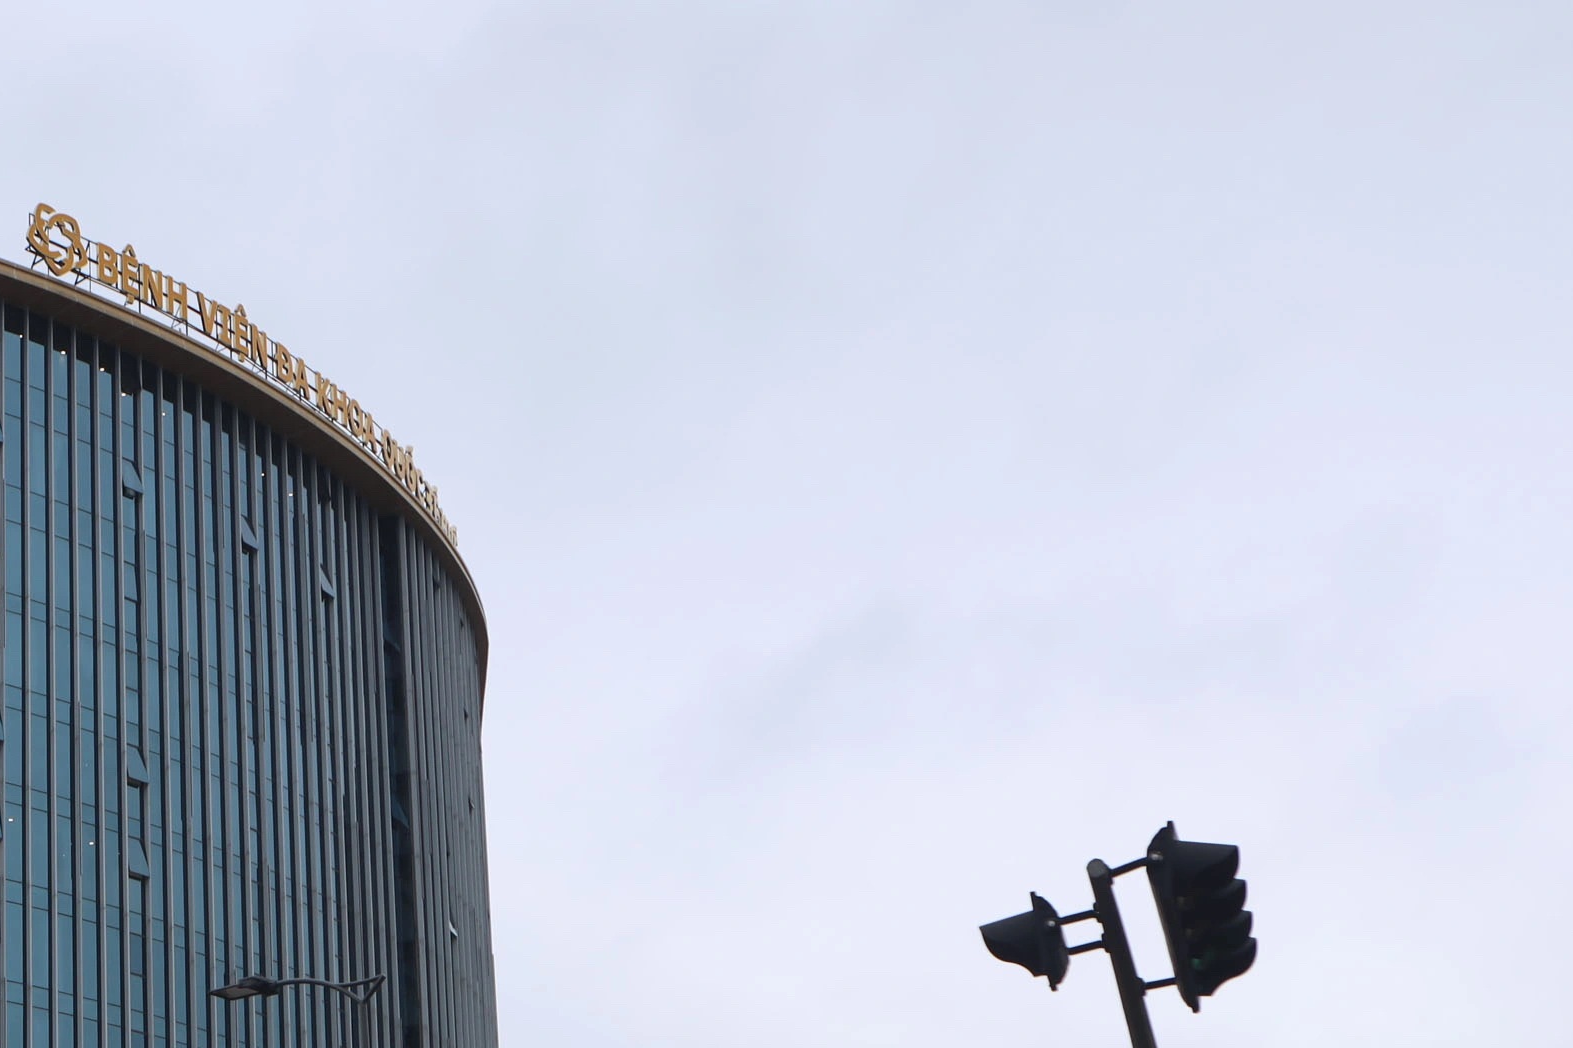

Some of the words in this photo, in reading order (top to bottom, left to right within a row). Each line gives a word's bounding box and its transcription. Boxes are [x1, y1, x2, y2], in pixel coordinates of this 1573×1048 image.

[97, 242, 189, 322] BỆNH
[197, 291, 268, 369] VIỆN
[276, 341, 311, 401] ĐA
[315, 371, 378, 454] KHOA
